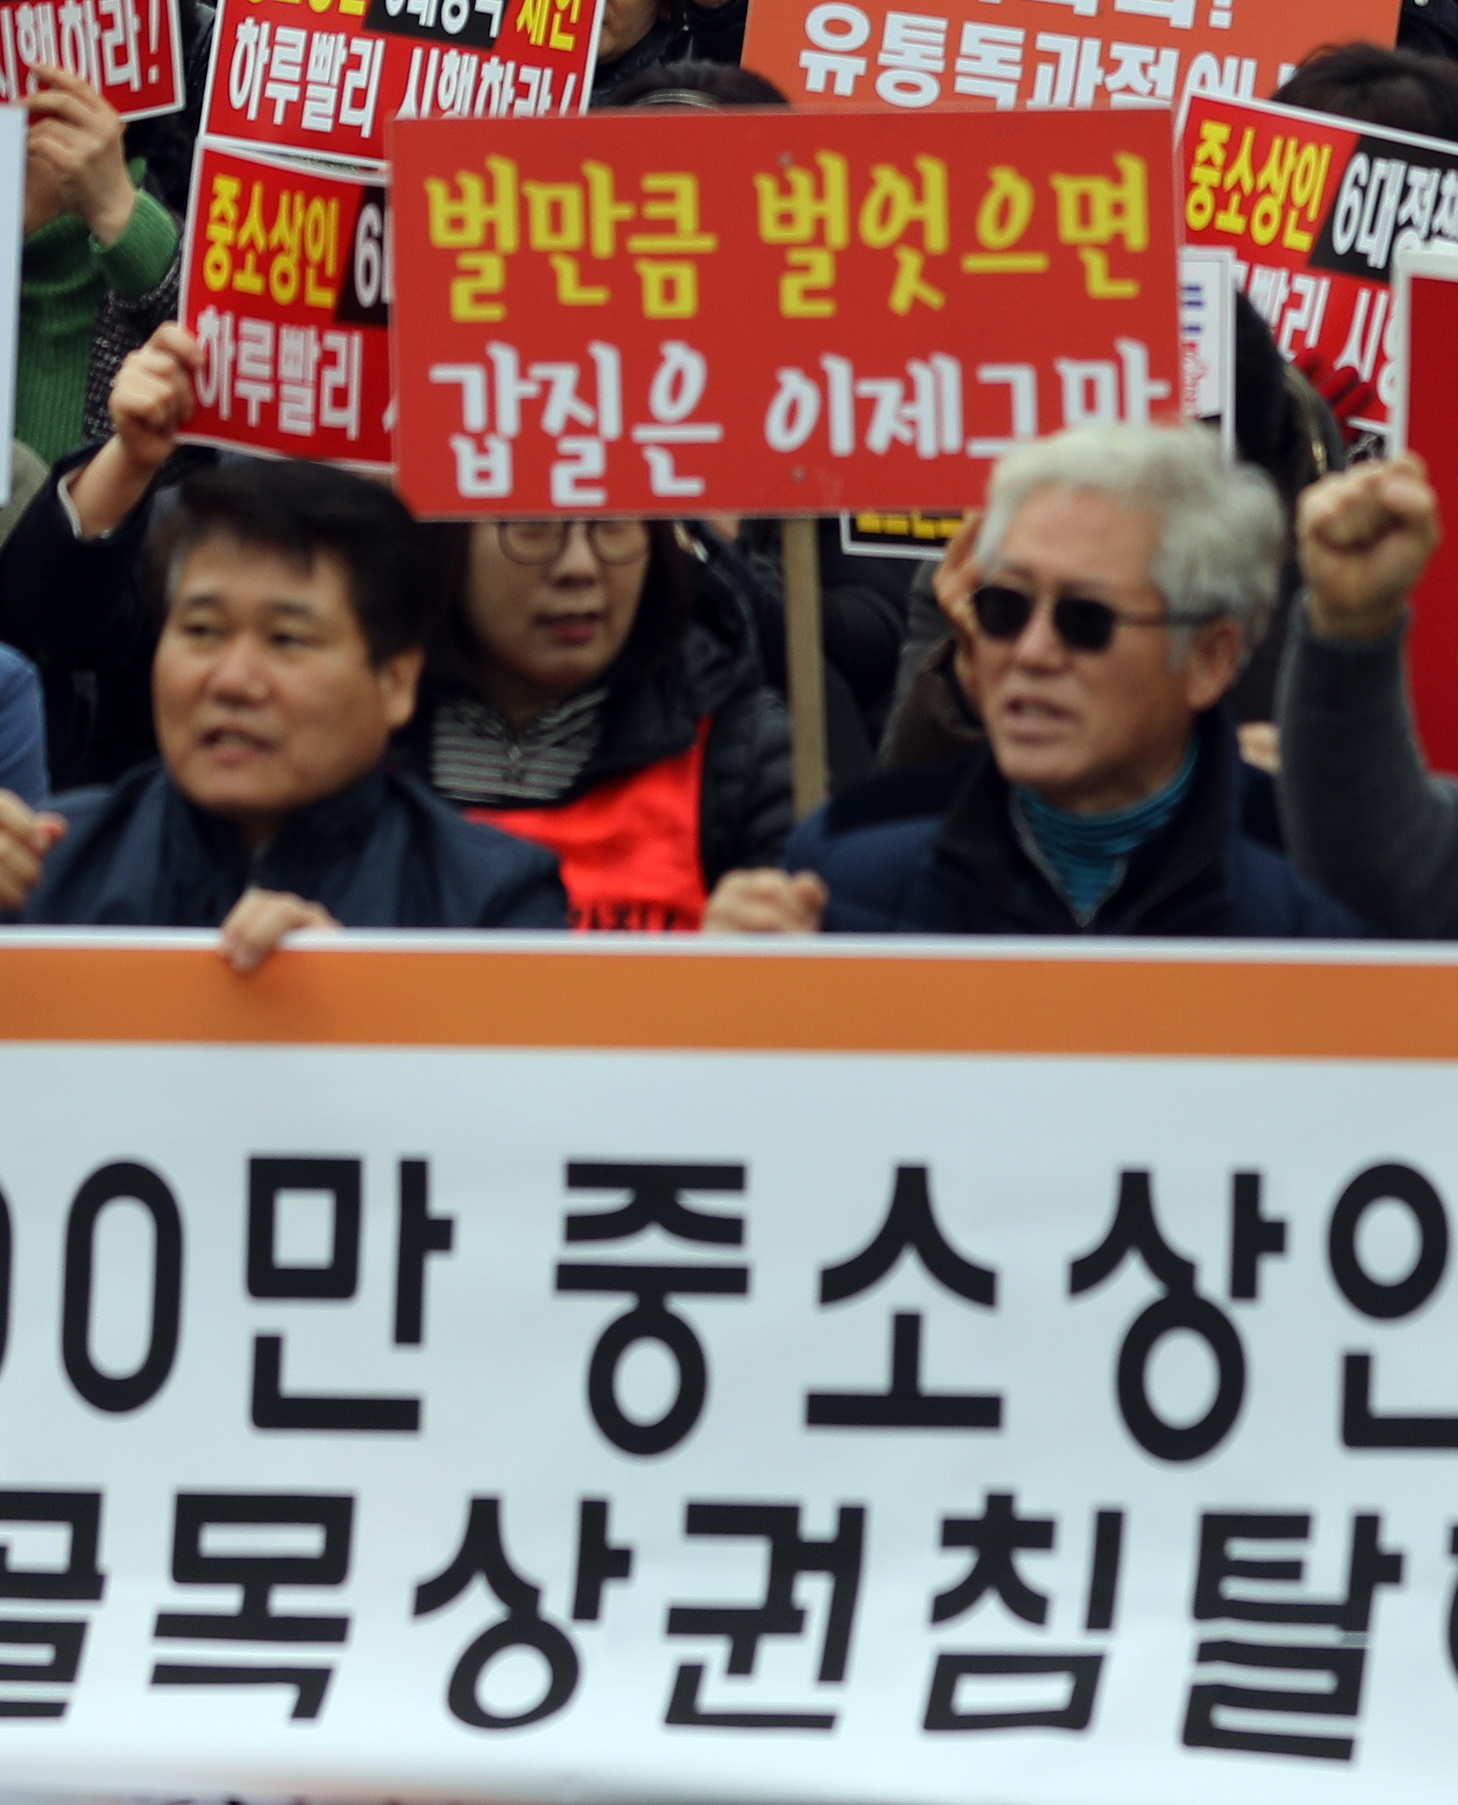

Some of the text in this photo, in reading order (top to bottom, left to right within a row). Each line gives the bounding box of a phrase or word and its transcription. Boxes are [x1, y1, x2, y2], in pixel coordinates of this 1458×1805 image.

[228, 18, 385, 138] 하루빨리
[202, 175, 337, 308] 중소상인
[425, 149, 1151, 321] 벌만큼 벌엇으면
[430, 340, 724, 507] 갑질은
